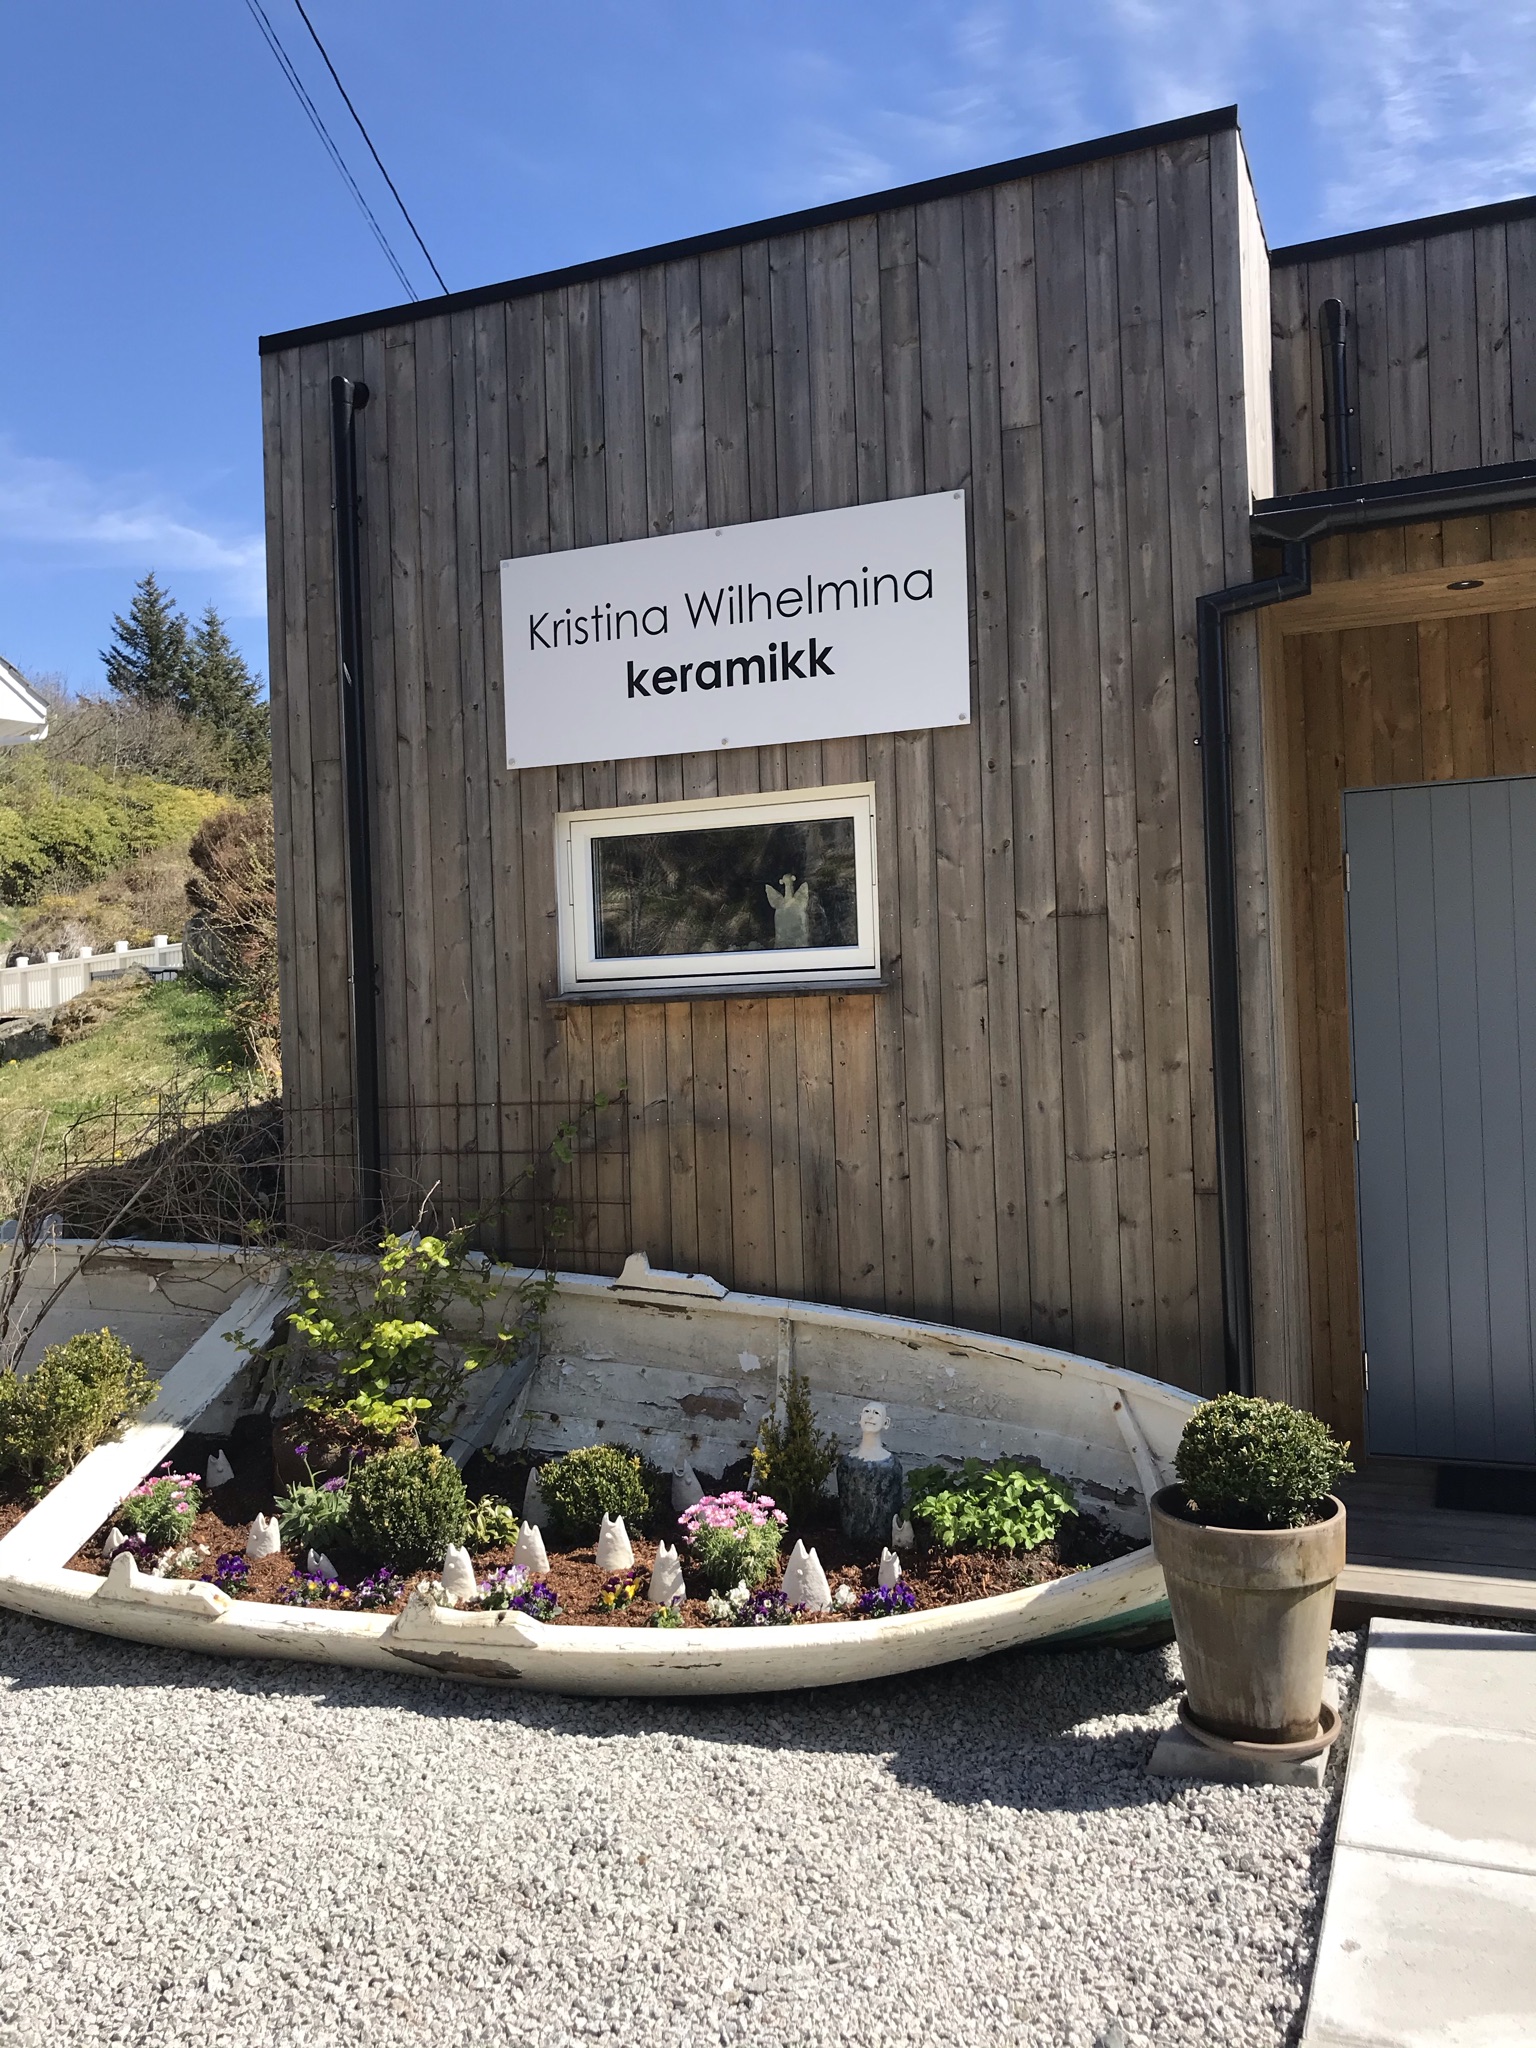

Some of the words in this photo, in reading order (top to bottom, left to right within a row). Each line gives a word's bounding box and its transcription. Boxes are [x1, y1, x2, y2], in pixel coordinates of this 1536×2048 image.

[529, 602, 668, 651] Kristina
[684, 566, 934, 629] Wilhelmina
[626, 637, 836, 699] keramikk
